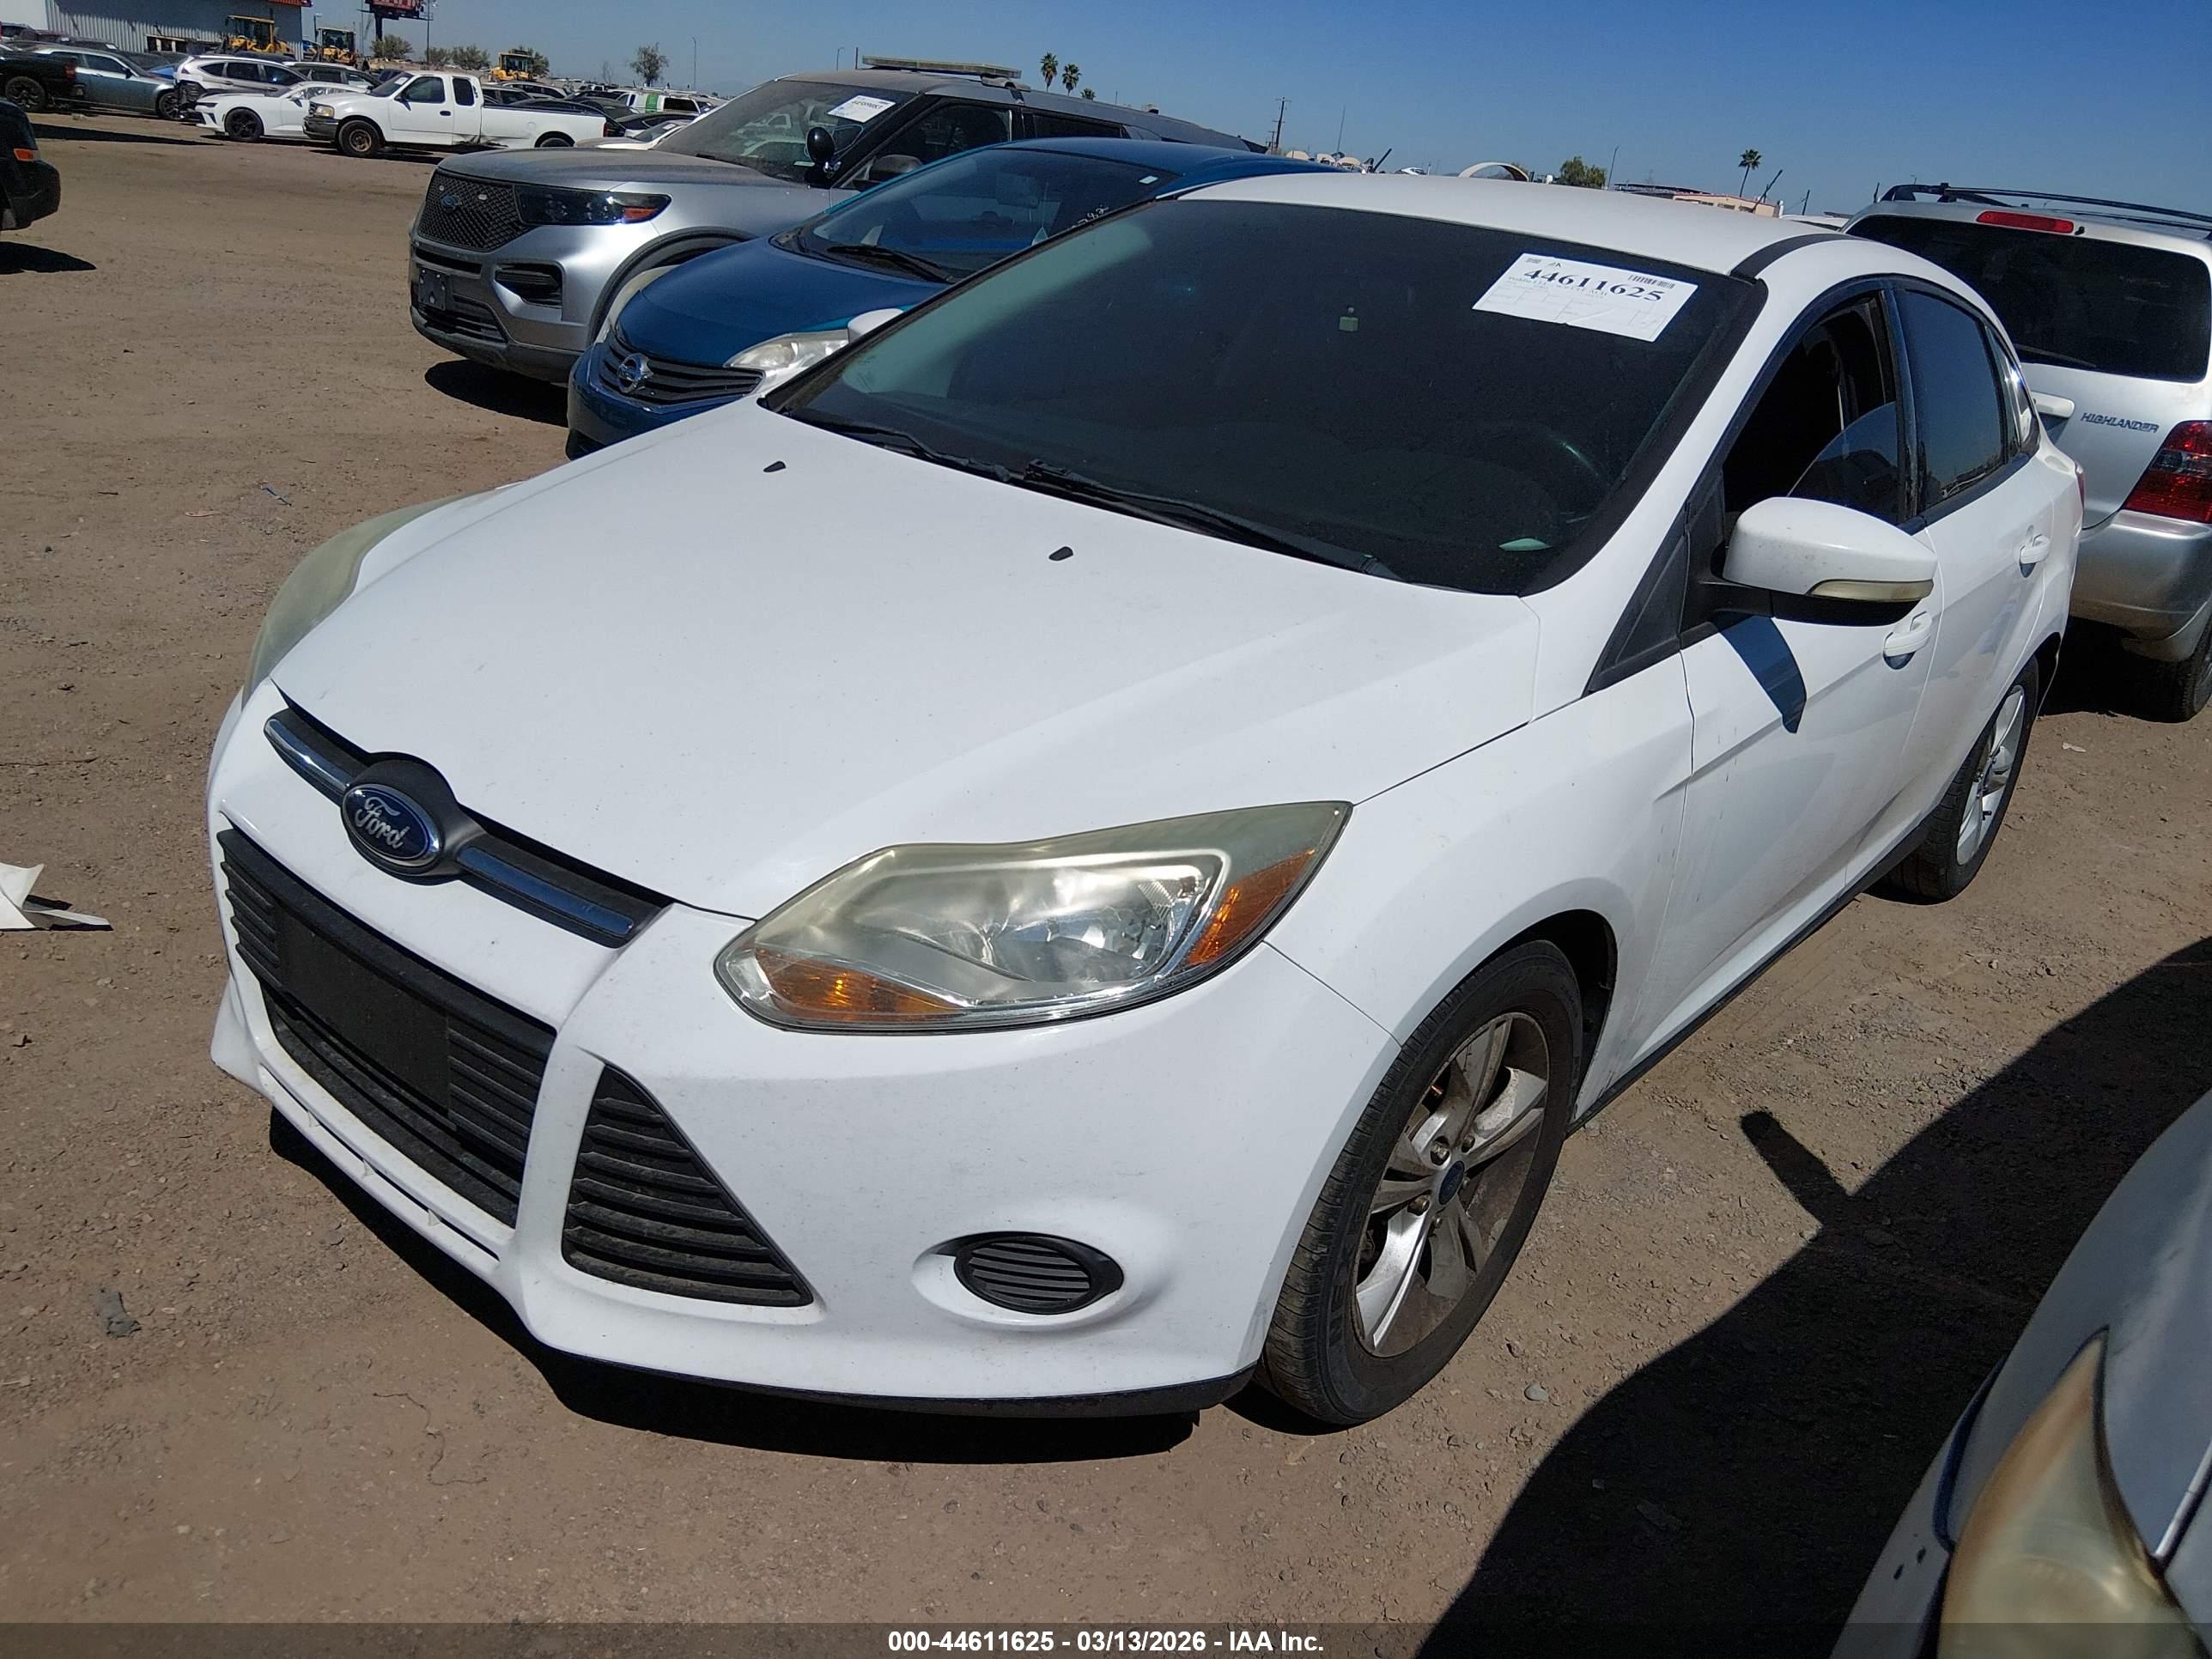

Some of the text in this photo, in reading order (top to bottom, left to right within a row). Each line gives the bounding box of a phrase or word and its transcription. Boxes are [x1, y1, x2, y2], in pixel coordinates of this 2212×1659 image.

[1524, 270, 1665, 301] 44611625
[2081, 412, 2160, 433] HIGHLANDER
[355, 797, 410, 848] Ford
